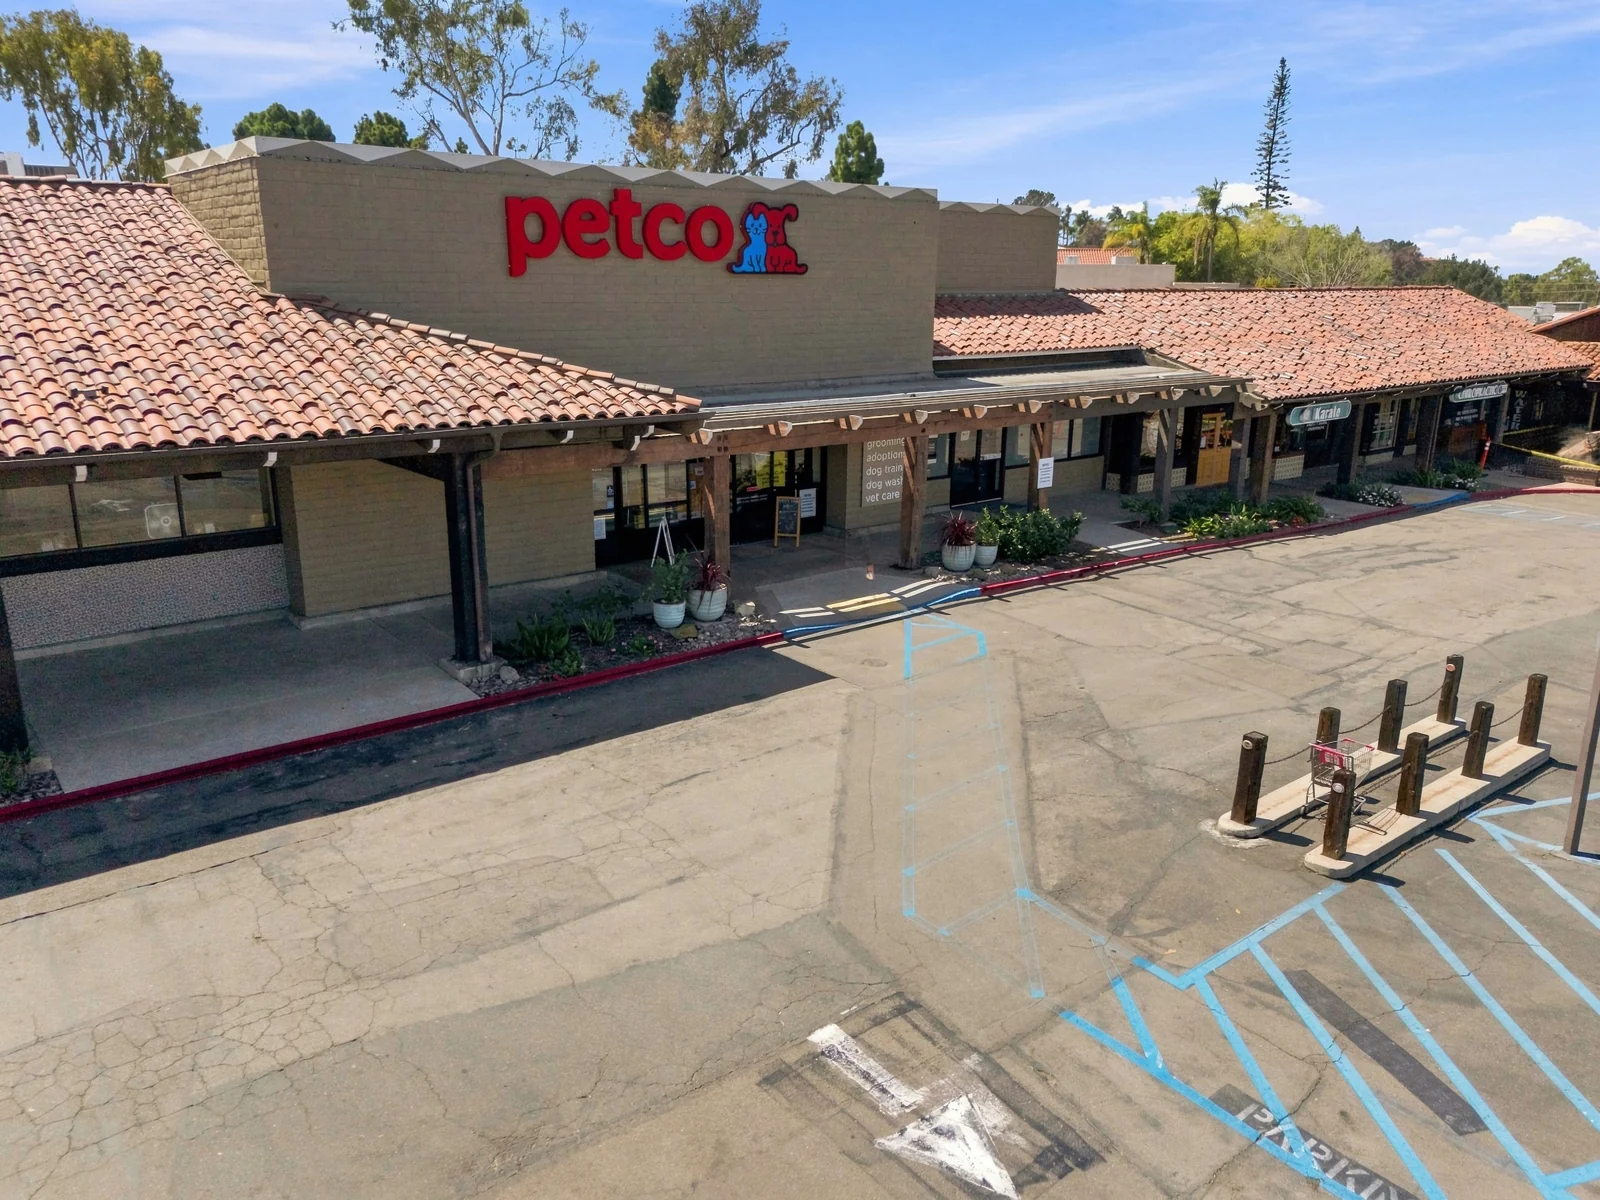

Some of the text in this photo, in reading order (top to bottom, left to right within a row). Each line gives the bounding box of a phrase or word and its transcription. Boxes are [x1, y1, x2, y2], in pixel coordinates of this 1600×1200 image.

[505, 188, 734, 277] petco
[1315, 406, 1341, 420] Karate
[866, 466, 882, 476] dog
[866, 480, 882, 490] dog
[865, 490, 900, 503] vet care
